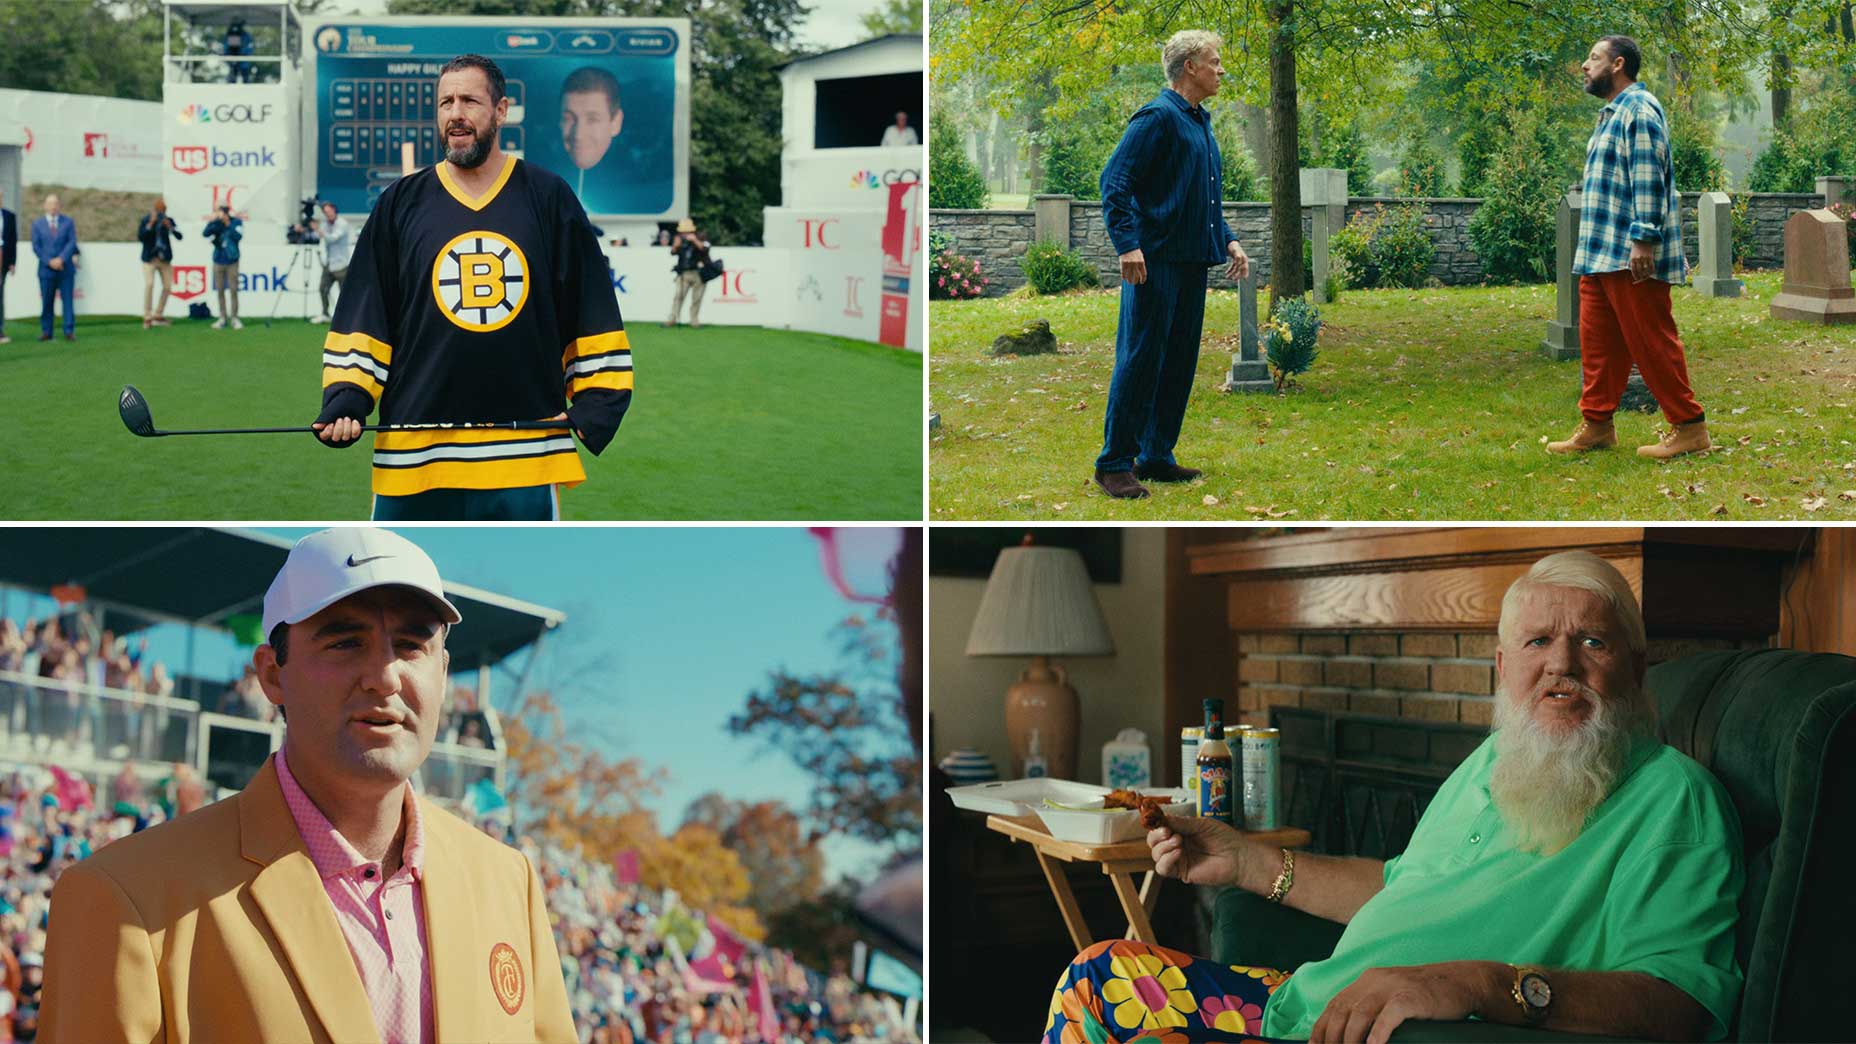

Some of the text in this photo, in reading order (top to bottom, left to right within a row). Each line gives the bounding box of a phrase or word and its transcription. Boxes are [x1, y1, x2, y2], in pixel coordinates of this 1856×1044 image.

[387, 63, 421, 75] HAPPY
[214, 104, 273, 123] GOLF
[212, 146, 275, 167] bank
[797, 219, 840, 249] TC
[459, 251, 506, 309] B
